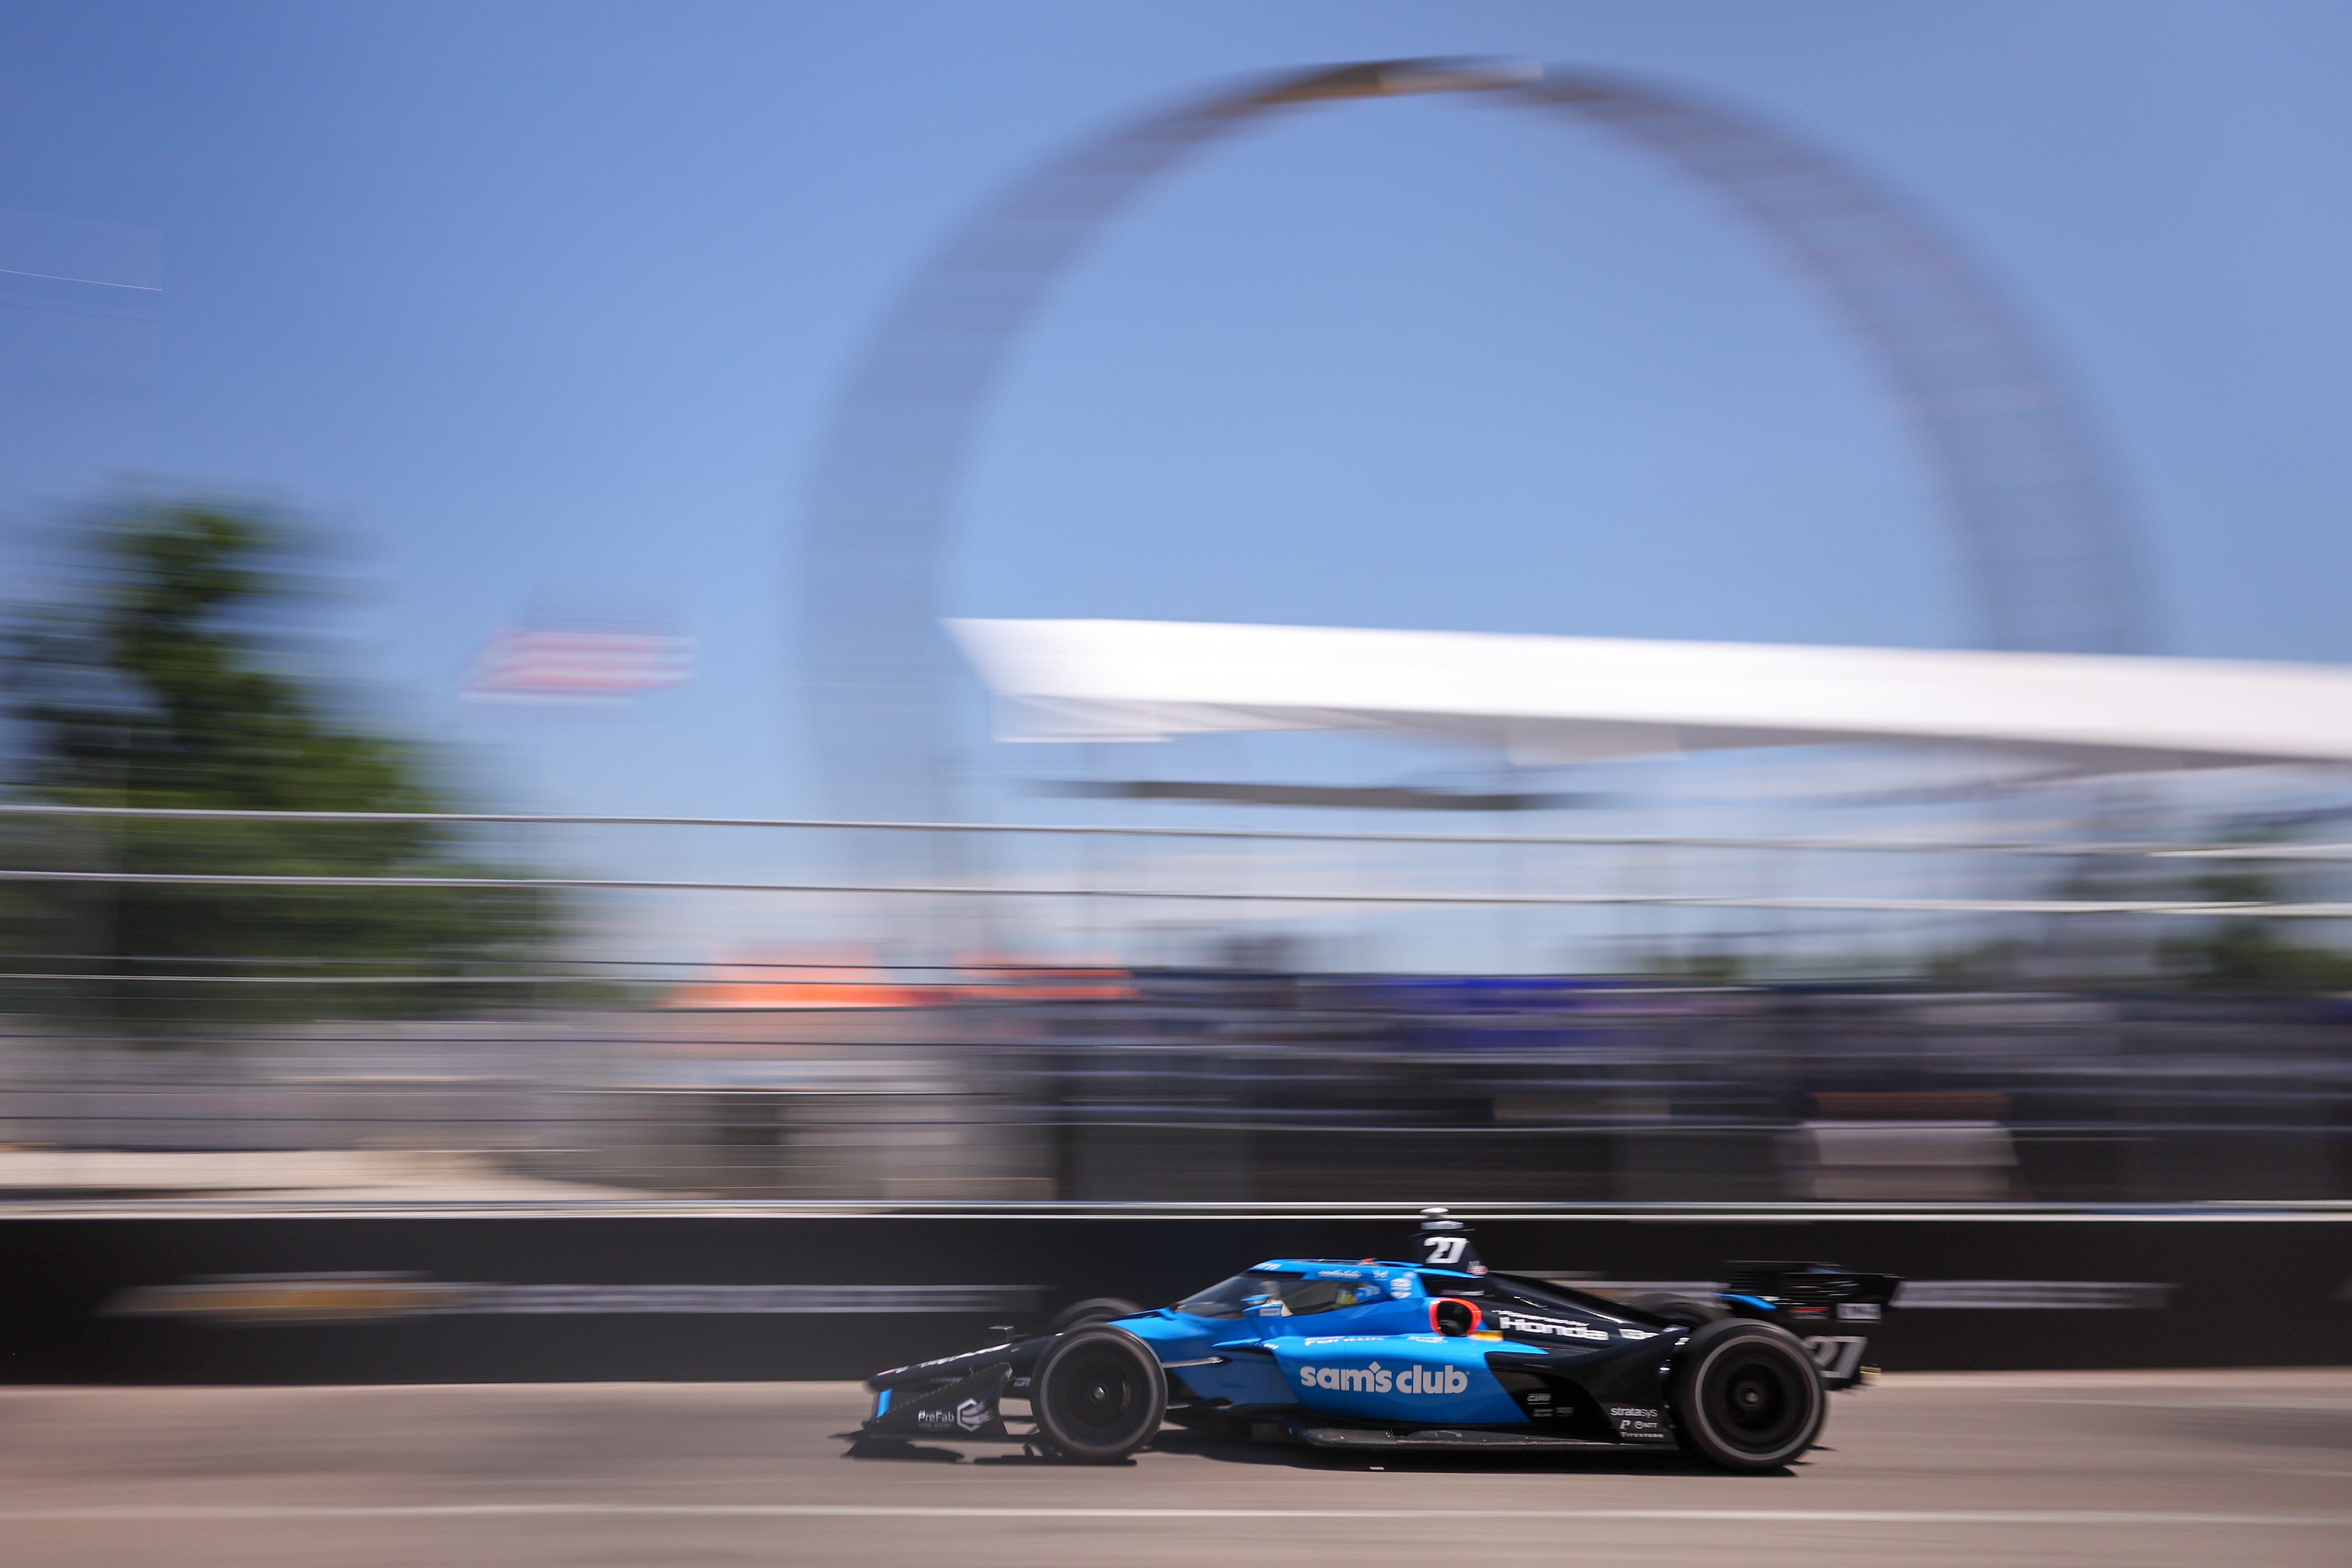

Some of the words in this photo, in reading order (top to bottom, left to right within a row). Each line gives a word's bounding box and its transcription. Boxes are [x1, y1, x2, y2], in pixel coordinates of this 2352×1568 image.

[1423, 1236, 1467, 1263] 27
[1499, 1317, 1609, 1341] Honda
[1802, 1336, 1868, 1379] 27
[1300, 1361, 1392, 1393] sam's
[1396, 1365, 1468, 1394] club
[918, 1410, 954, 1422] PreFab
[1610, 1407, 1658, 1418] stratasys
